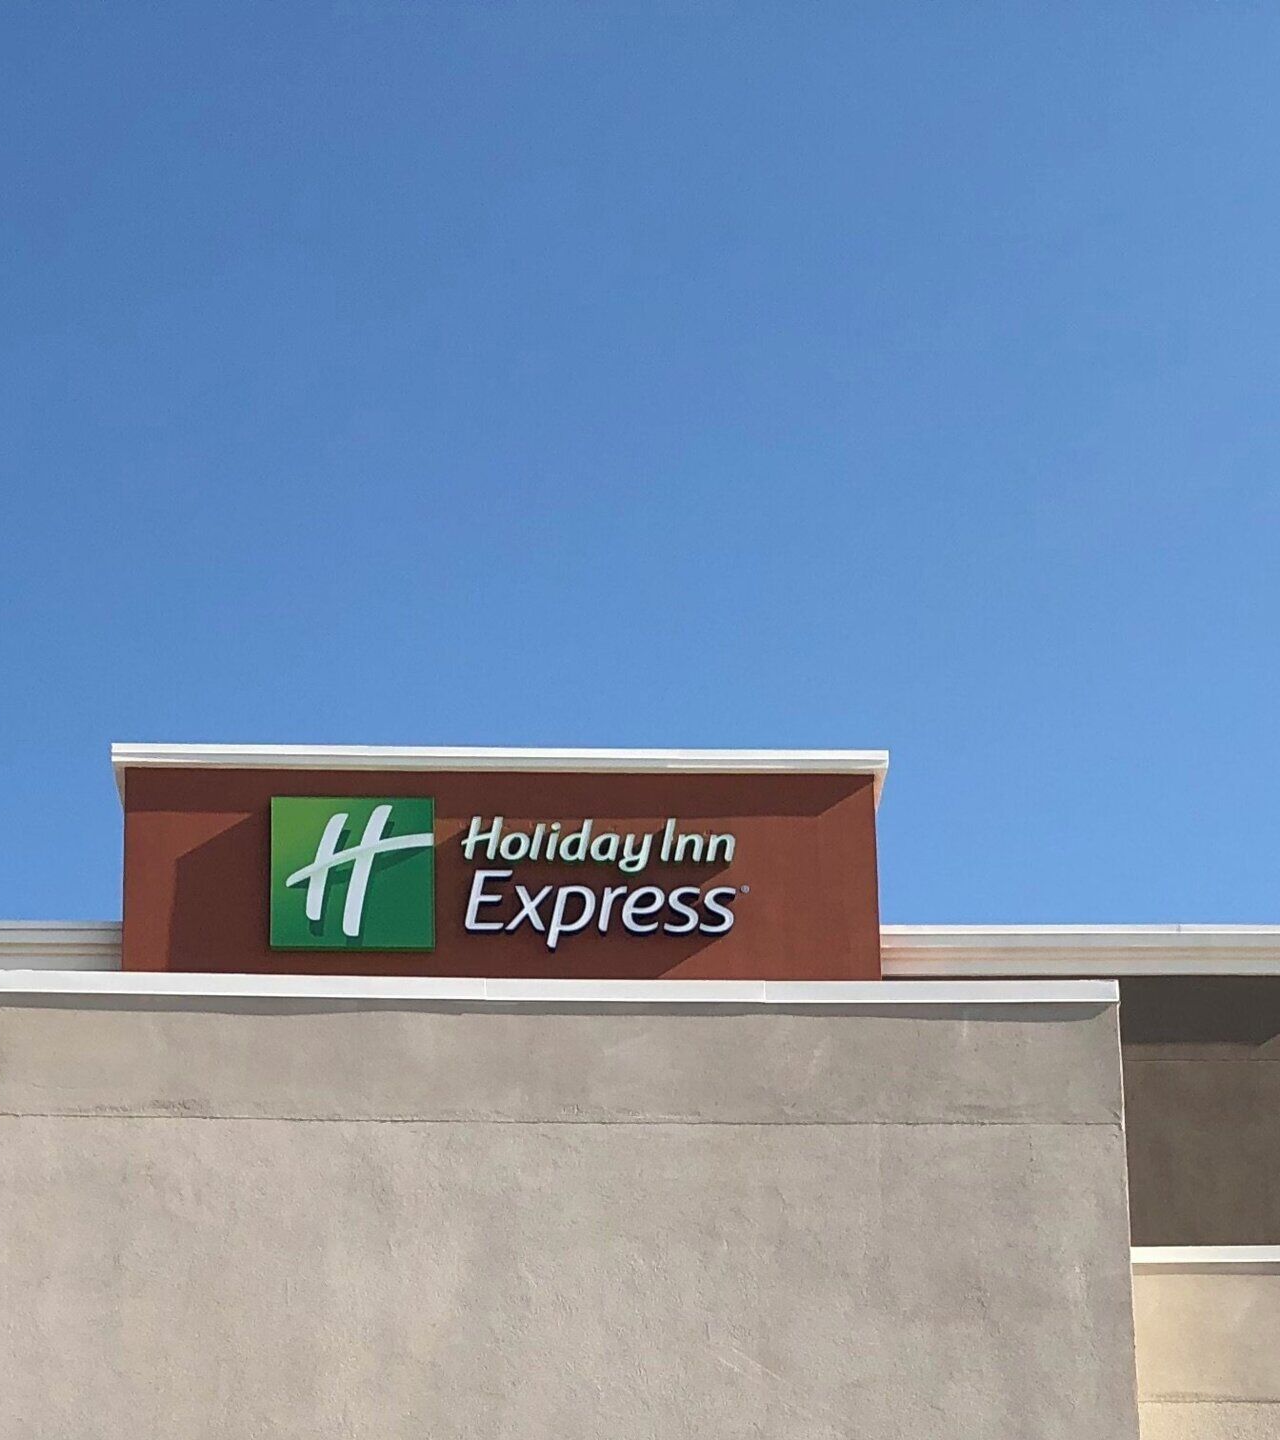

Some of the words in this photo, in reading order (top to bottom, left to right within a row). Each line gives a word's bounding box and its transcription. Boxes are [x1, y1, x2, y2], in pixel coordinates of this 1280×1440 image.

[461, 816, 652, 873] Holiday
[660, 817, 736, 862] Inn
[464, 868, 737, 949] Express
